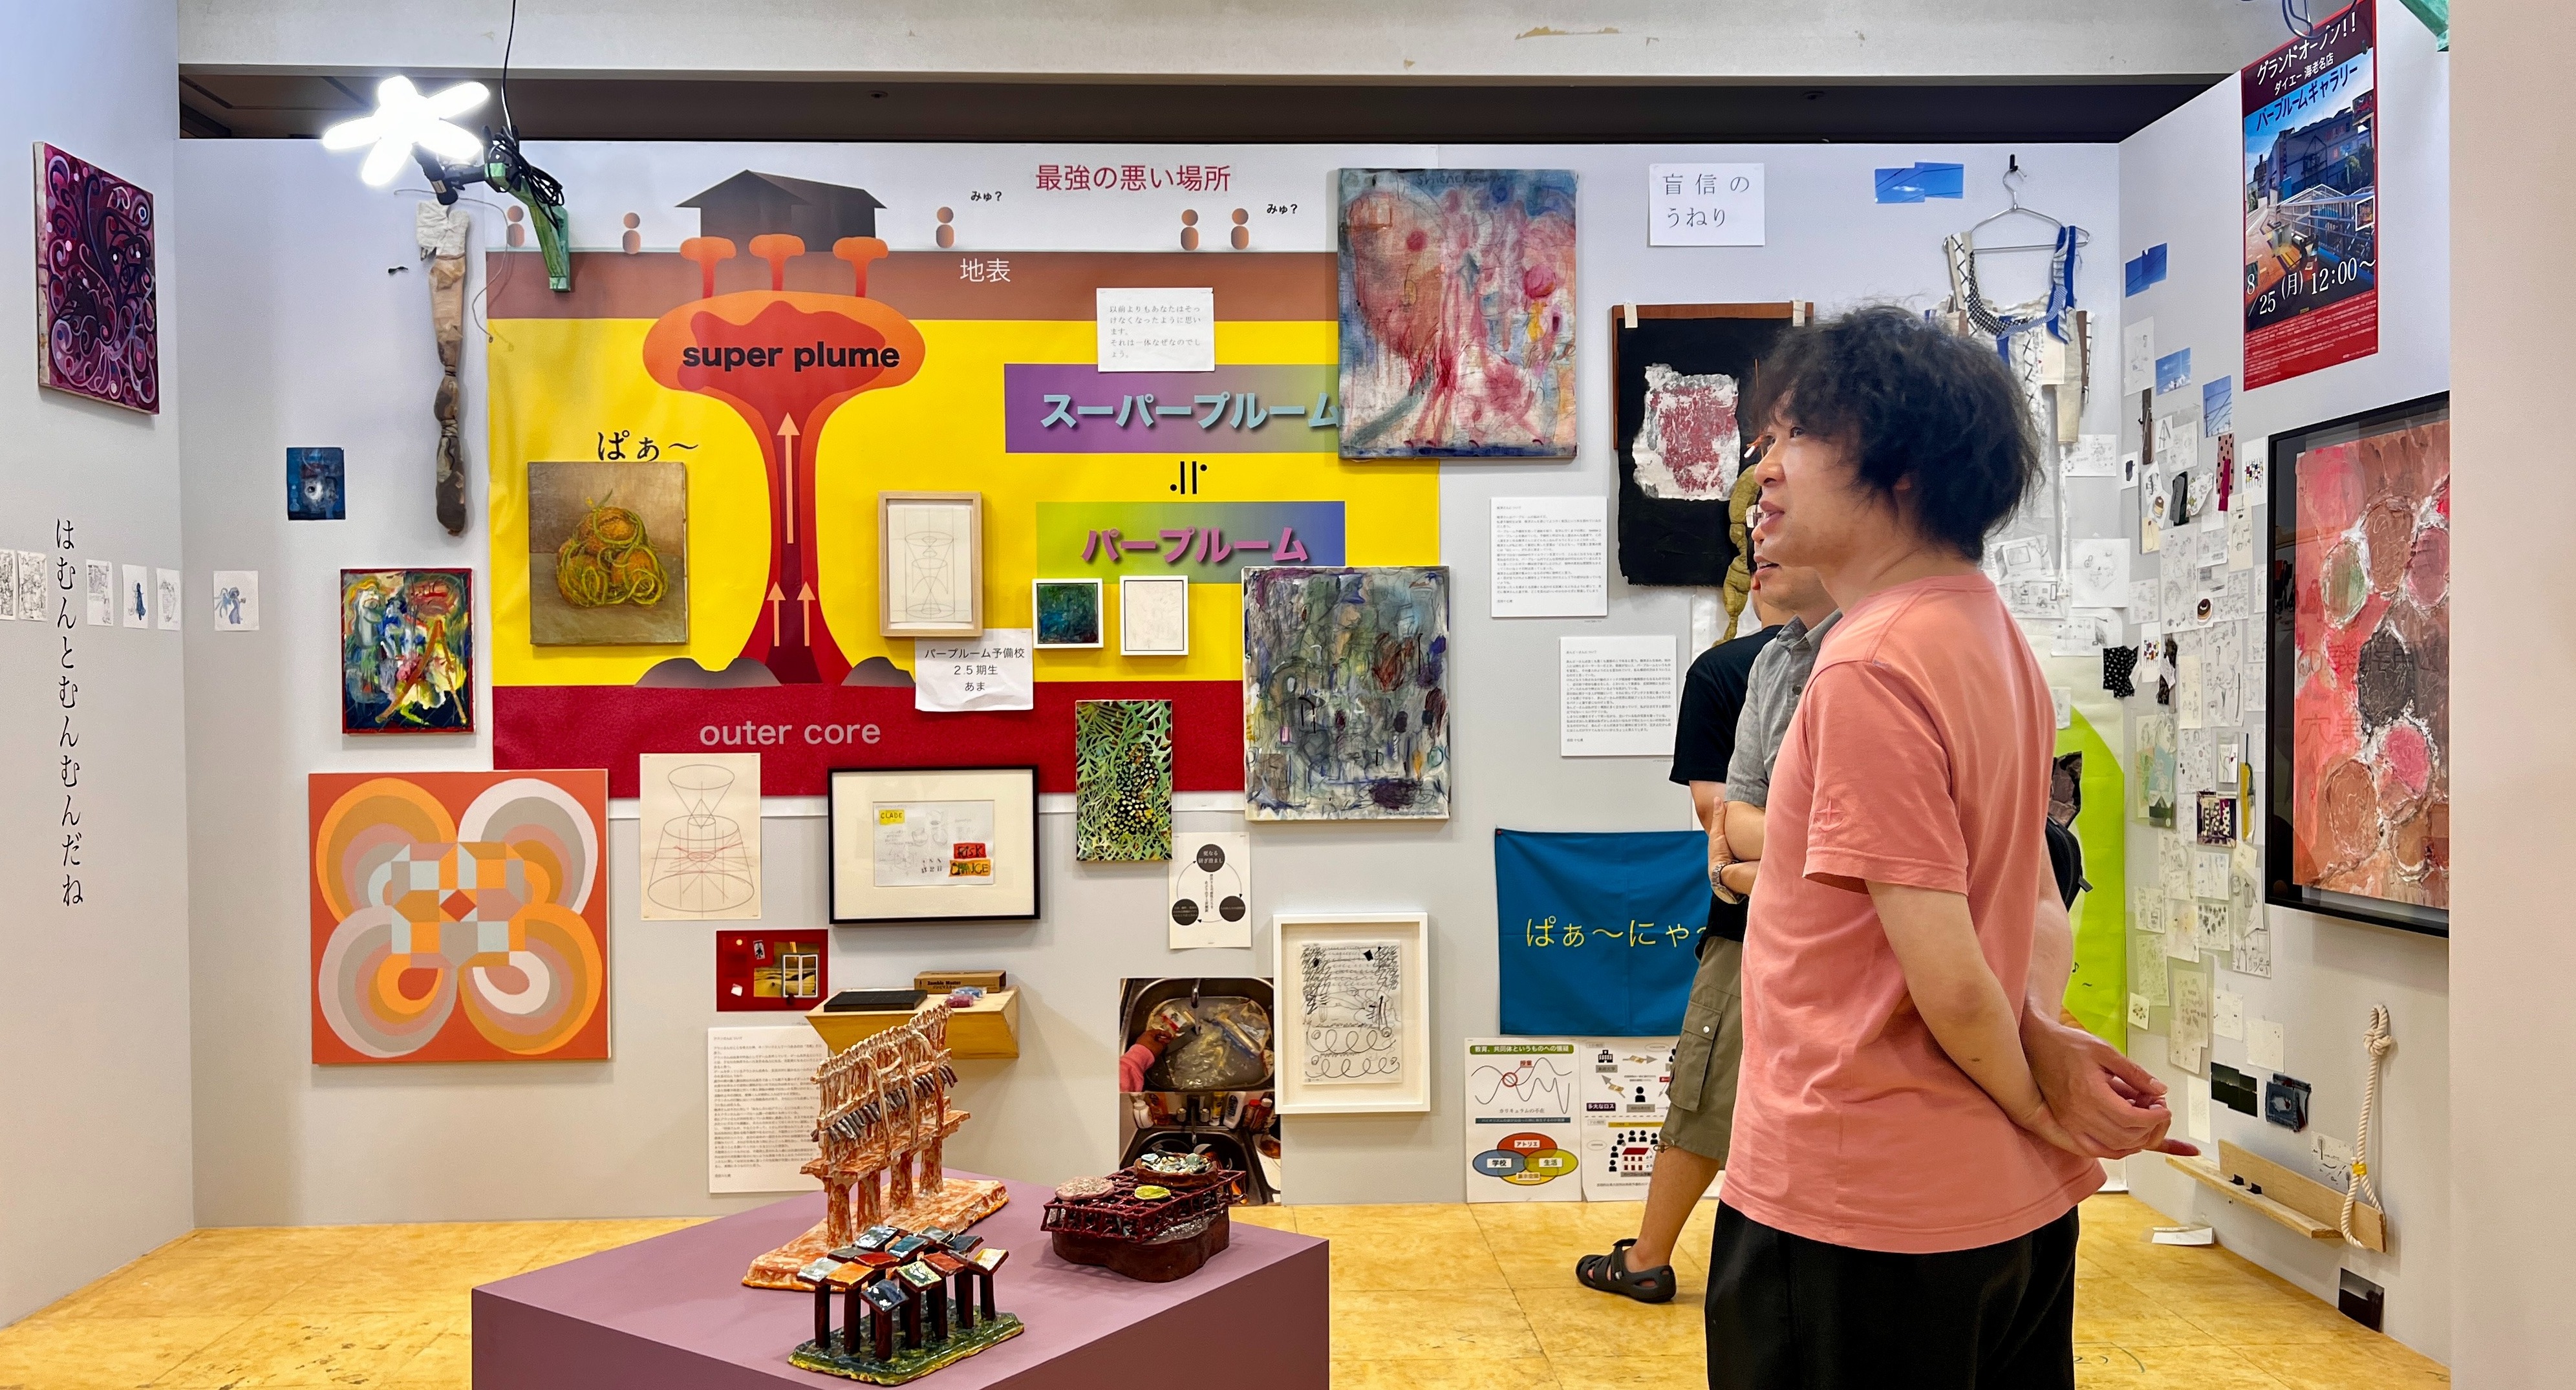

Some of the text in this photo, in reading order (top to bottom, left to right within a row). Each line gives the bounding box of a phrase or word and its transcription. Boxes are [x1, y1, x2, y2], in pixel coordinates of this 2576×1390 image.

[2274, 52, 2334, 96] ダイエー 海老名店
[1036, 164, 1231, 192] 最強の悪い場所
[1662, 173, 1750, 196] 盲信の
[1666, 207, 1726, 229] うねり
[960, 257, 1011, 283] 地表
[2281, 270, 2304, 300] (月)
[682, 341, 901, 373] super plume
[1040, 390, 1339, 429] スーパープルーム
[597, 429, 700, 462] ぱぁ〜
[1080, 526, 1309, 562] パープルーム
[924, 647, 1025, 659] パープルーム予備校
[965, 681, 985, 692] あま
[56, 519, 83, 907] はむんとむんむんだね
[700, 721, 881, 746] outer core
[1491, 1159, 1507, 1168] 学校
